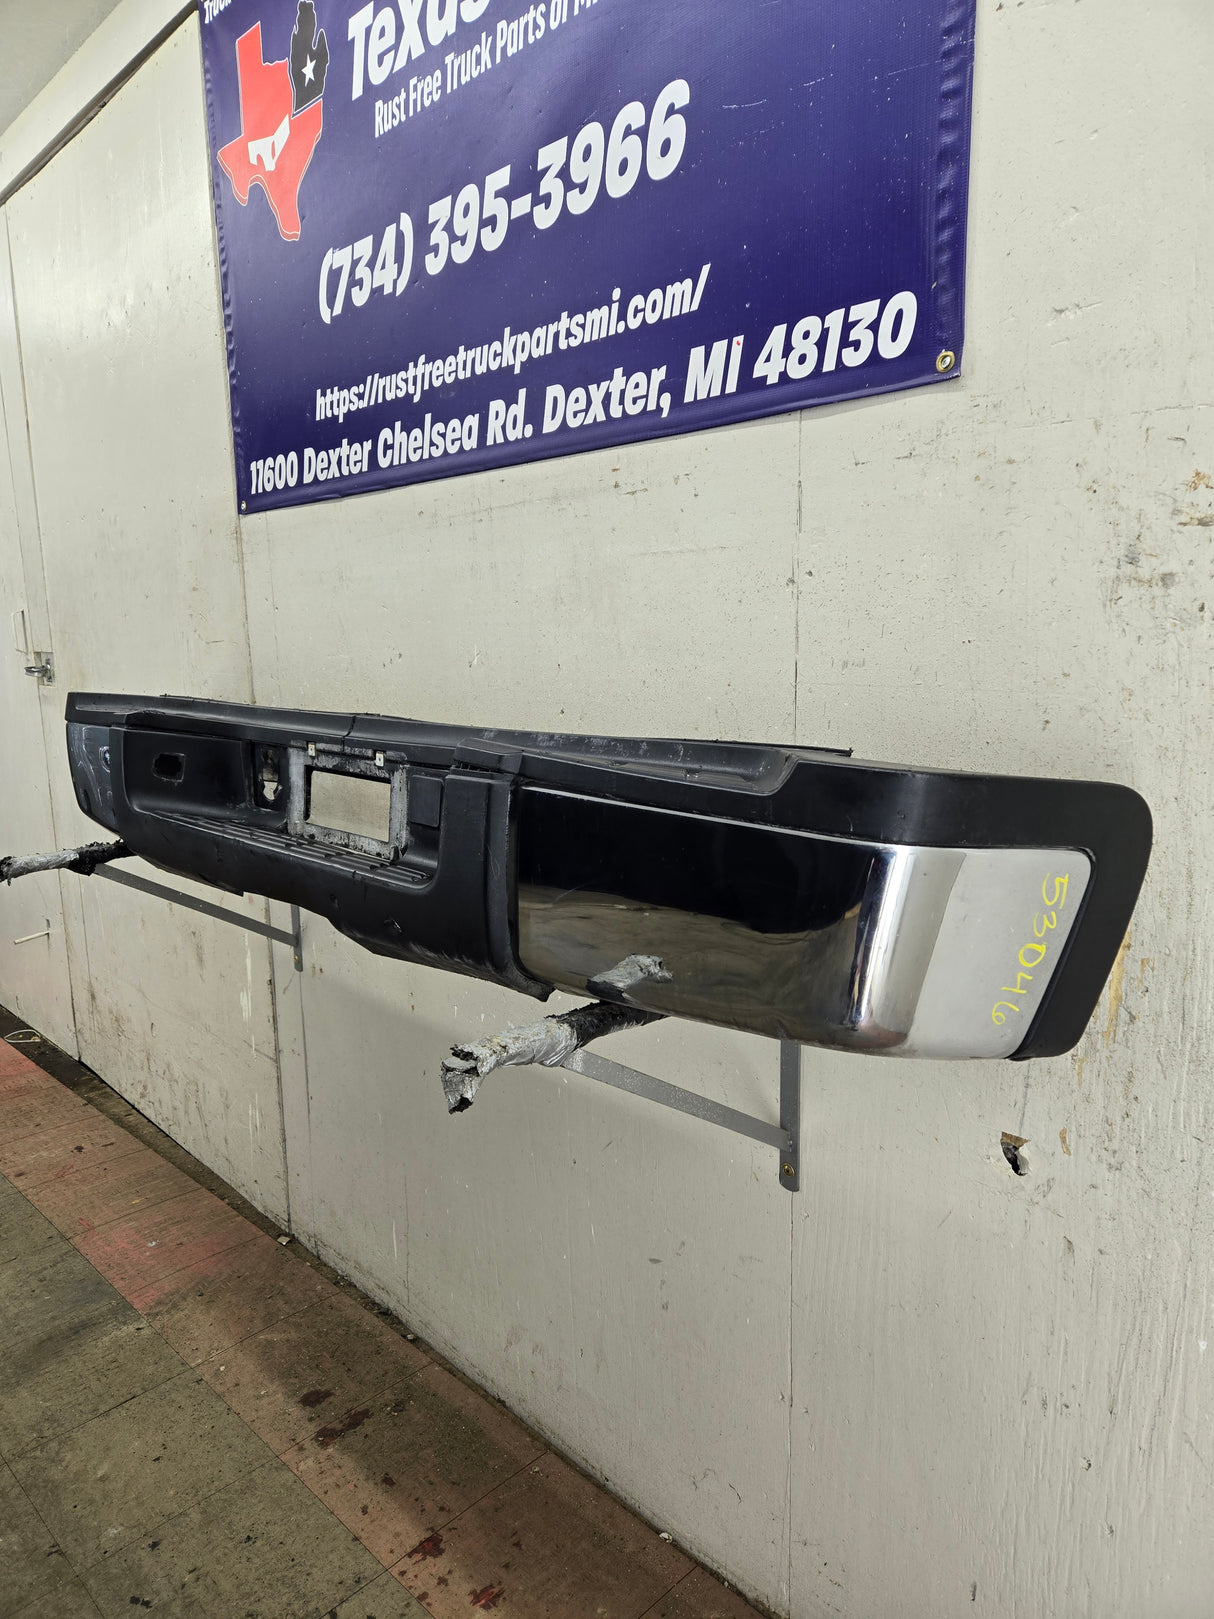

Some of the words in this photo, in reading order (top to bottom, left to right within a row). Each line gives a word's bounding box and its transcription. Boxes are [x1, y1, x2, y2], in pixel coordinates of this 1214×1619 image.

[203, 0, 232, 24] Truc
[348, 0, 490, 101] Texa
[374, 88, 407, 139] Rust
[408, 69, 443, 118] Free
[444, 31, 493, 95] Truck
[495, 2, 547, 65] Parts
[319, 212, 415, 325] (734)
[424, 78, 691, 276] 395-3966
[250, 451, 300, 495] 11600
[302, 437, 373, 485] Dexter
[376, 412, 480, 468] Chelsea
[485, 387, 534, 446] Rd.
[541, 363, 673, 434] Dexter,
[682, 334, 745, 404] MI
[751, 290, 919, 386] 48130
[315, 263, 712, 424] https://rustfreetruckpartsmi.com/
